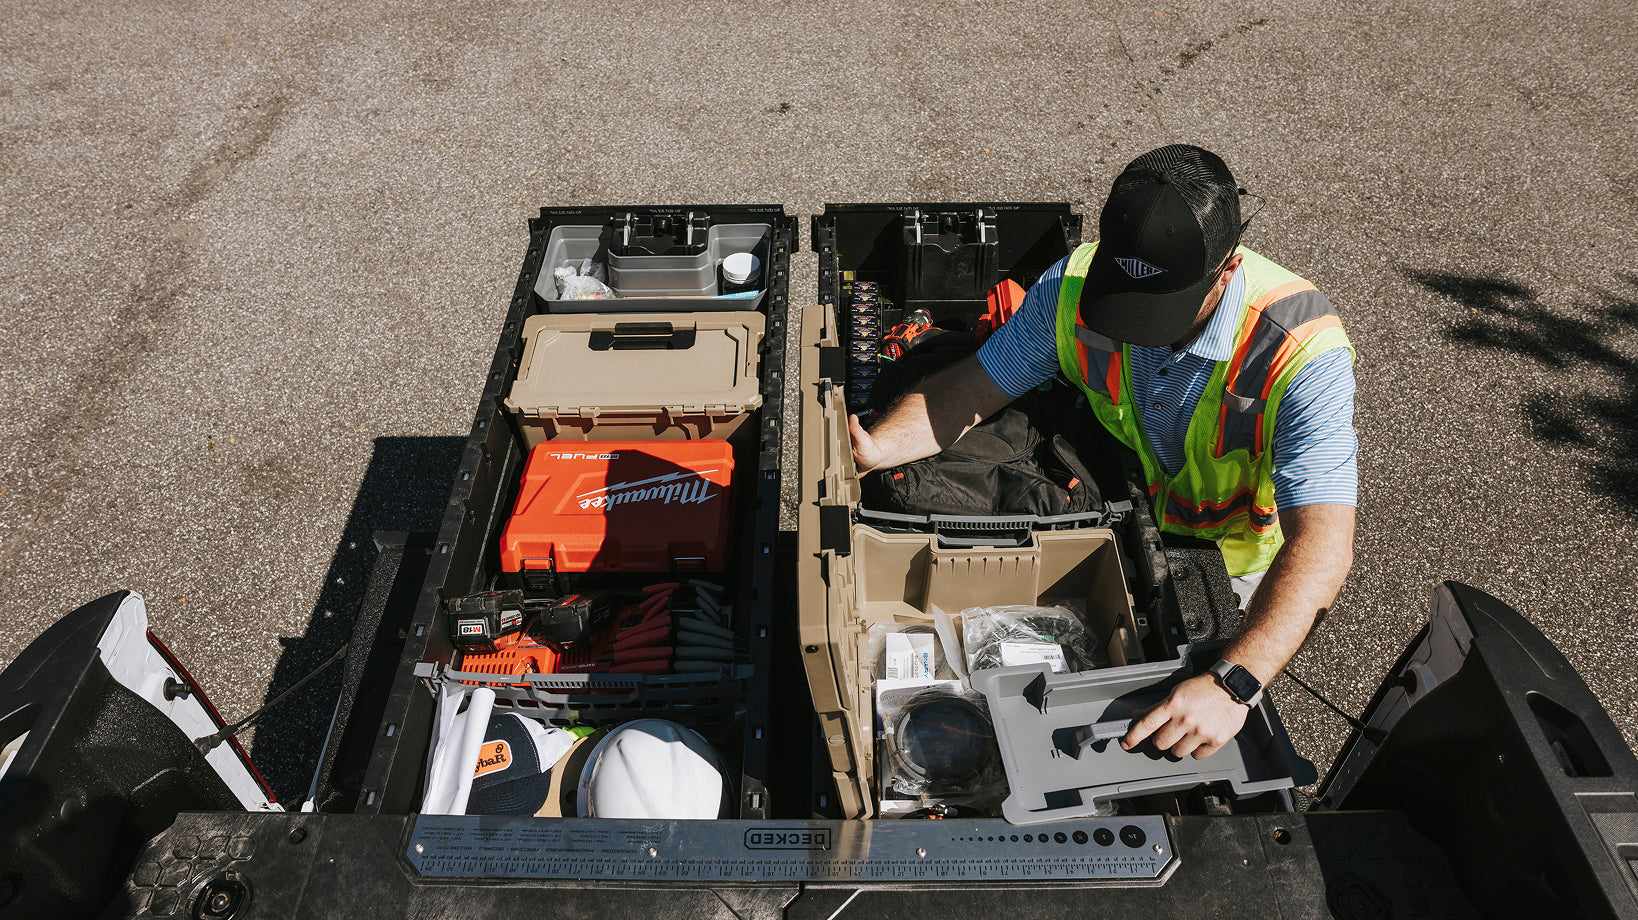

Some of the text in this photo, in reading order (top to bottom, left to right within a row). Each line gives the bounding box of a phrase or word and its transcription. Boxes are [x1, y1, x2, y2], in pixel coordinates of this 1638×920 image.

[578, 478, 718, 511] Milwaukee
[462, 626, 481, 634] M18
[750, 833, 825, 845] DECKED
